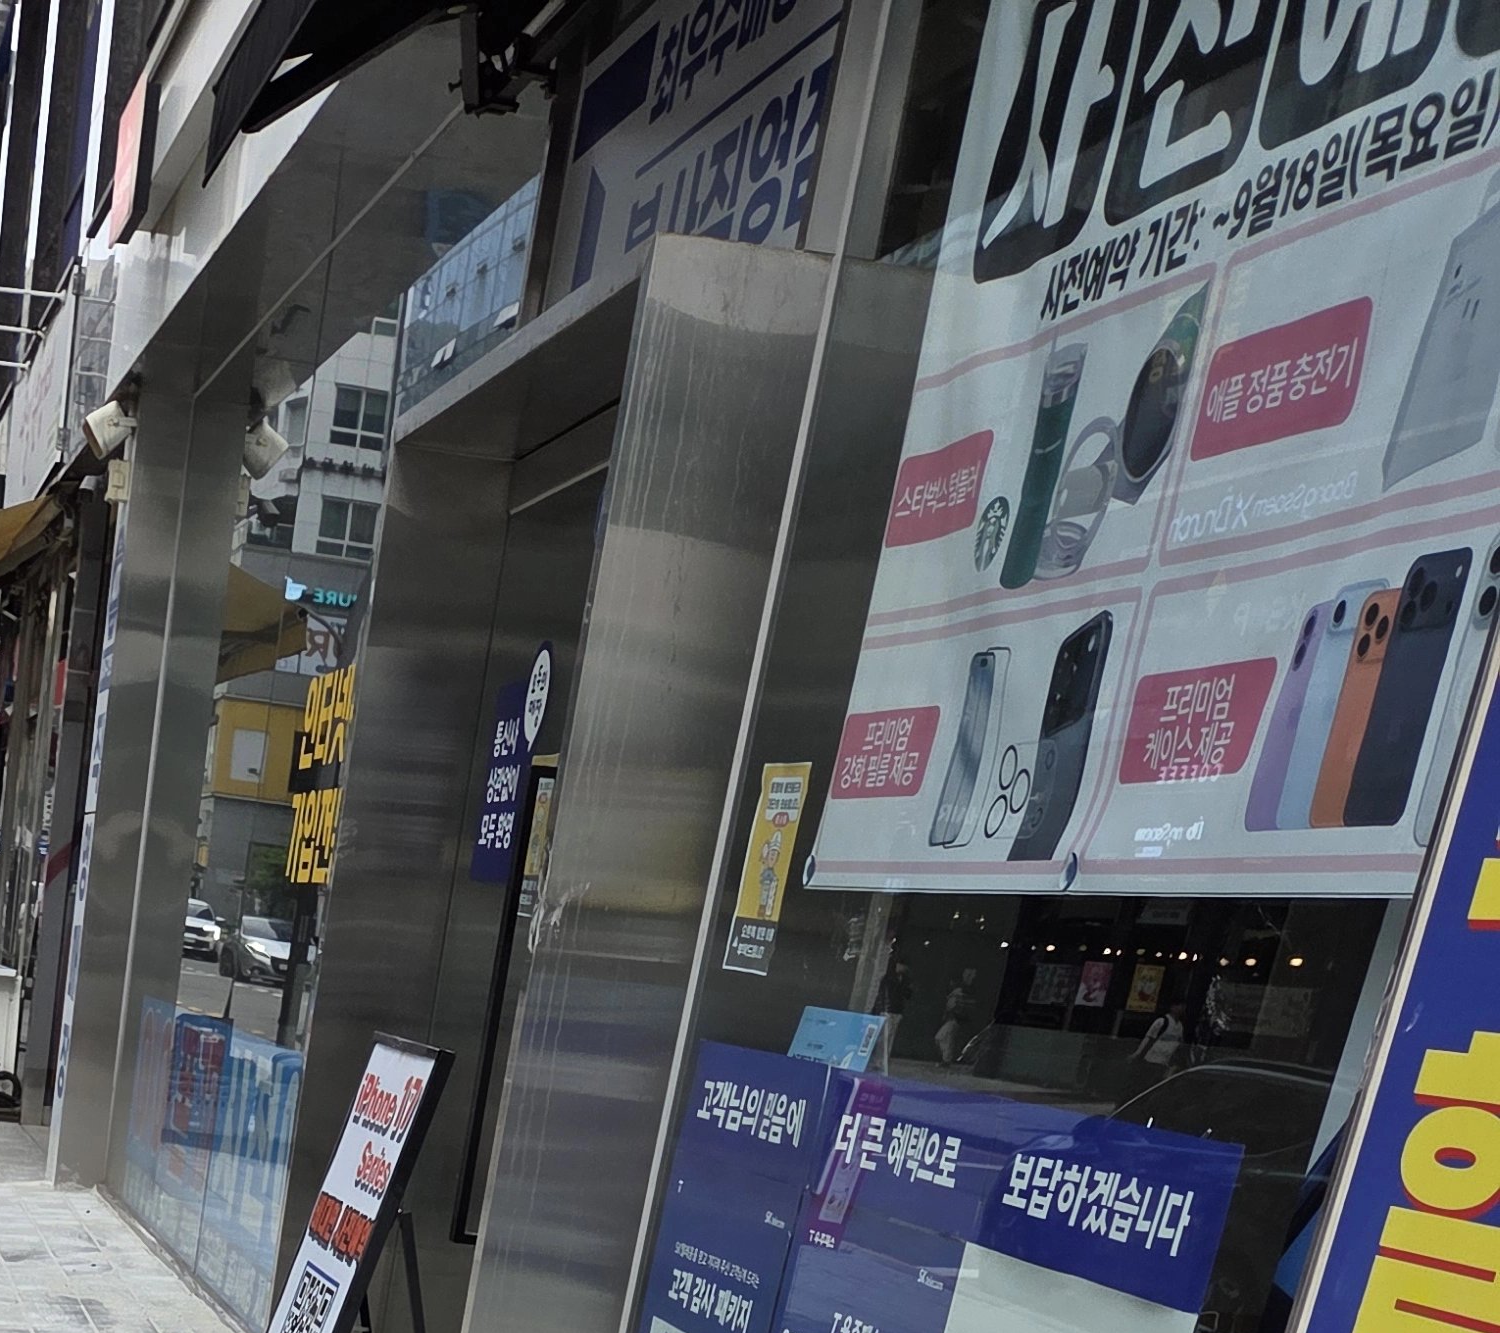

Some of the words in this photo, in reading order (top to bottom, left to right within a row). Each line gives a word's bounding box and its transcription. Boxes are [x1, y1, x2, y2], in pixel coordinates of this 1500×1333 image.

[1039, 222, 1142, 321] 사전예약
[1138, 198, 1206, 279] 기간:
[1206, 372, 1247, 424] 애플
[1246, 360, 1292, 414] 정품
[1288, 336, 1359, 402] 충전기
[298, 663, 357, 771] 인터넷
[1162, 673, 1237, 724] 프리미엄
[493, 717, 521, 758] 통신사
[862, 715, 915, 752] 프리미엄
[1143, 724, 1195, 771] 케이스
[1193, 721, 1236, 767] 제공
[486, 764, 521, 803] 상관없이
[839, 757, 867, 790] 강화
[865, 753, 891, 788] 필름
[888, 751, 920, 788] 제공
[478, 813, 498, 849] 모두
[353, 1073, 398, 1137] iPhone
[697, 1080, 765, 1136] 고객님의
[758, 1089, 806, 1148] 믿음에
[355, 1140, 393, 1200] Series
[835, 1112, 863, 1164] 더
[860, 1116, 887, 1171] 큰
[887, 1122, 961, 1188] 혜택으로
[1001, 1153, 1194, 1257] 보답하겠습니다
[668, 1267, 692, 1309] 고객
[690, 1277, 718, 1319] 감사
